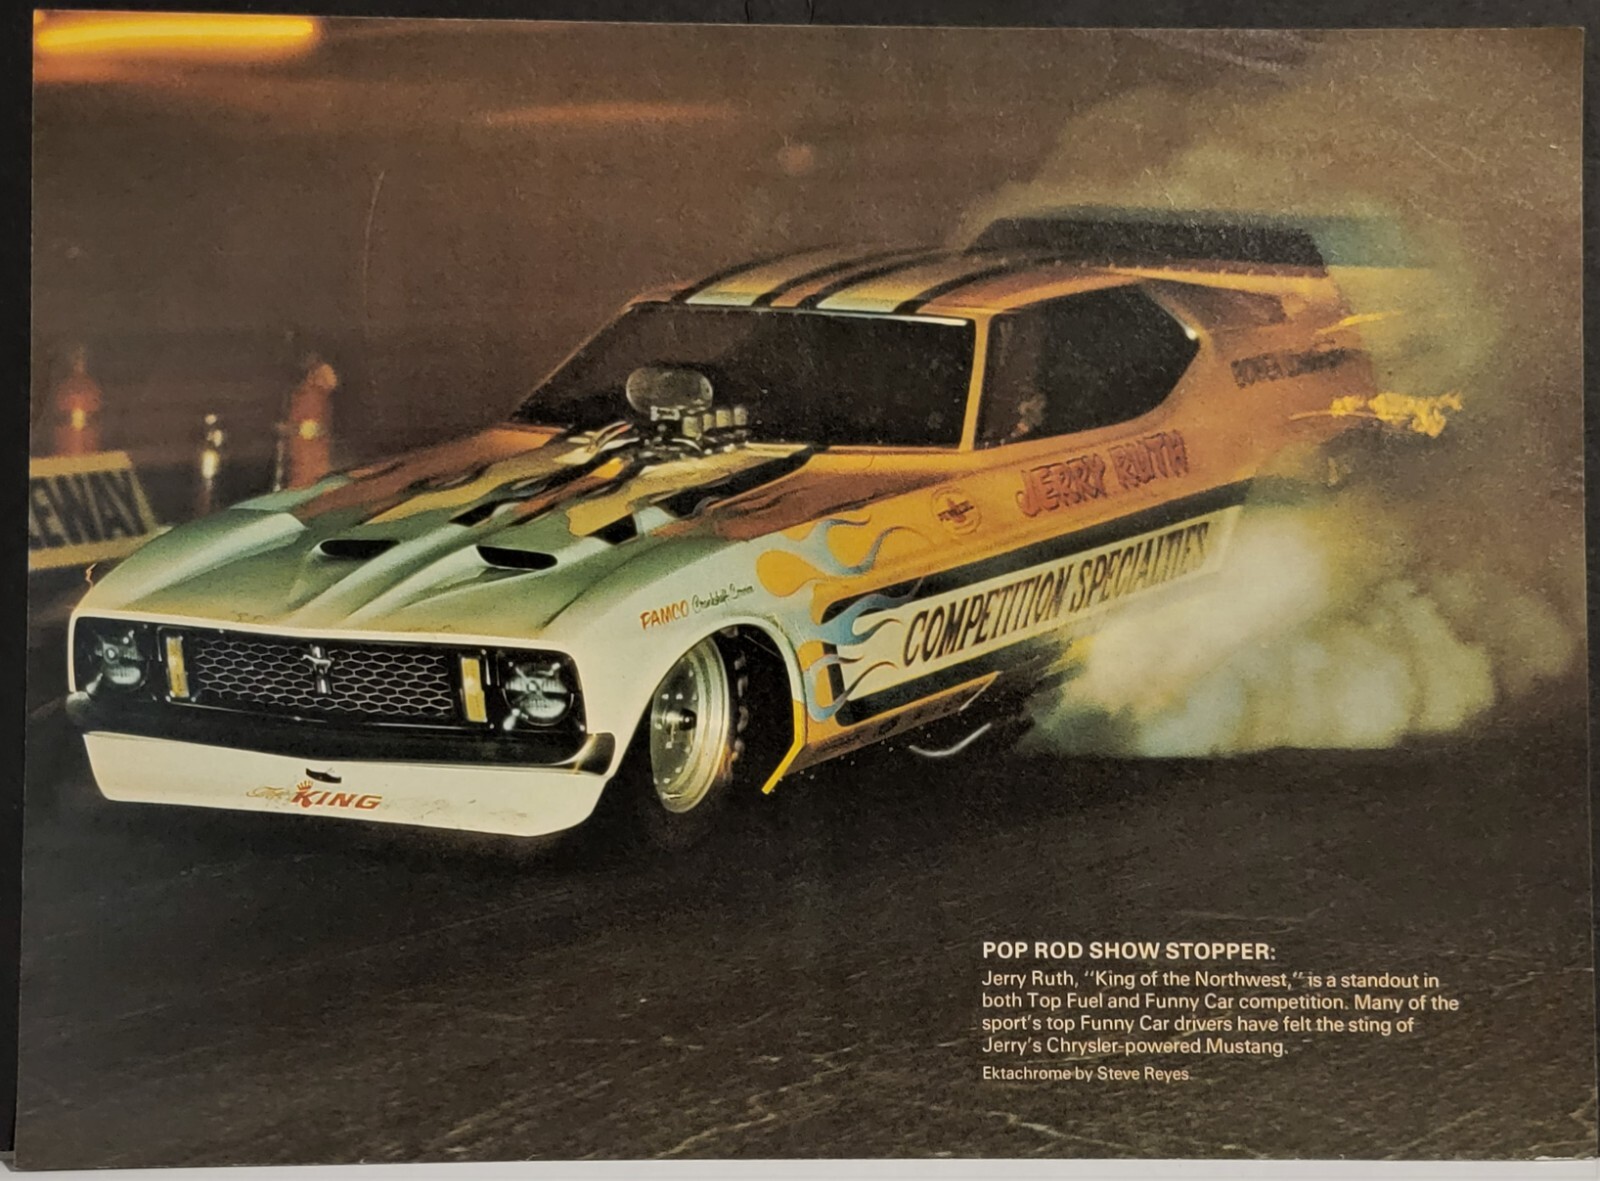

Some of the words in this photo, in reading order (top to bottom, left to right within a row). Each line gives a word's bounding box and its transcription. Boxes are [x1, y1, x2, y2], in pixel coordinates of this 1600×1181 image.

[1015, 453, 1107, 517] JERRY
[1108, 430, 1190, 490] RUTH
[903, 564, 1074, 667] COMPETITION
[291, 789, 383, 810] KING
[982, 941, 1028, 959] POP
[1034, 941, 1083, 959] ROD
[1089, 941, 1161, 960] SHOW
[1165, 941, 1276, 960] STOPPER:
[981, 970, 1027, 989] Jerry
[1031, 970, 1079, 988] Ruth,
[1140, 970, 1158, 987] of
[1162, 970, 1191, 987] the
[1307, 972, 1323, 988] is
[1326, 975, 1337, 988] a
[1340, 972, 1420, 989] standout
[1423, 972, 1440, 988] in
[982, 991, 1022, 1008] both
[1026, 992, 1062, 1012] Top
[1067, 992, 1103, 1009] Fuel
[1107, 992, 1140, 1009] and
[1145, 992, 1200, 1012] Funny
[1204, 992, 1234, 1010] Car
[1238, 993, 1349, 1013] competition.
[1354, 993, 1404, 1014] Many
[1408, 994, 1427, 1011] of
[1430, 994, 1460, 1011] the
[982, 1014, 1042, 1034] sport's
[1046, 1016, 1076, 1034] top
[1080, 1014, 1135, 1034] Funny
[1139, 1014, 1170, 1032] Car
[1174, 1014, 1233, 1032] drivers
[1237, 1015, 1279, 1032] have
[1282, 1015, 1312, 1032] felt
[1315, 1015, 1345, 1033] the
[1348, 1015, 1392, 1037] sting
[1396, 1016, 1415, 1033] of
[982, 1036, 1042, 1056] Jerry's
[1046, 1036, 1201, 1057] Chrysler-powered
[1205, 1037, 1289, 1058] Mustang.
[982, 1065, 1074, 1081] Ektachrome
[1074, 1065, 1094, 1083] by
[1097, 1065, 1140, 1081] Steve
